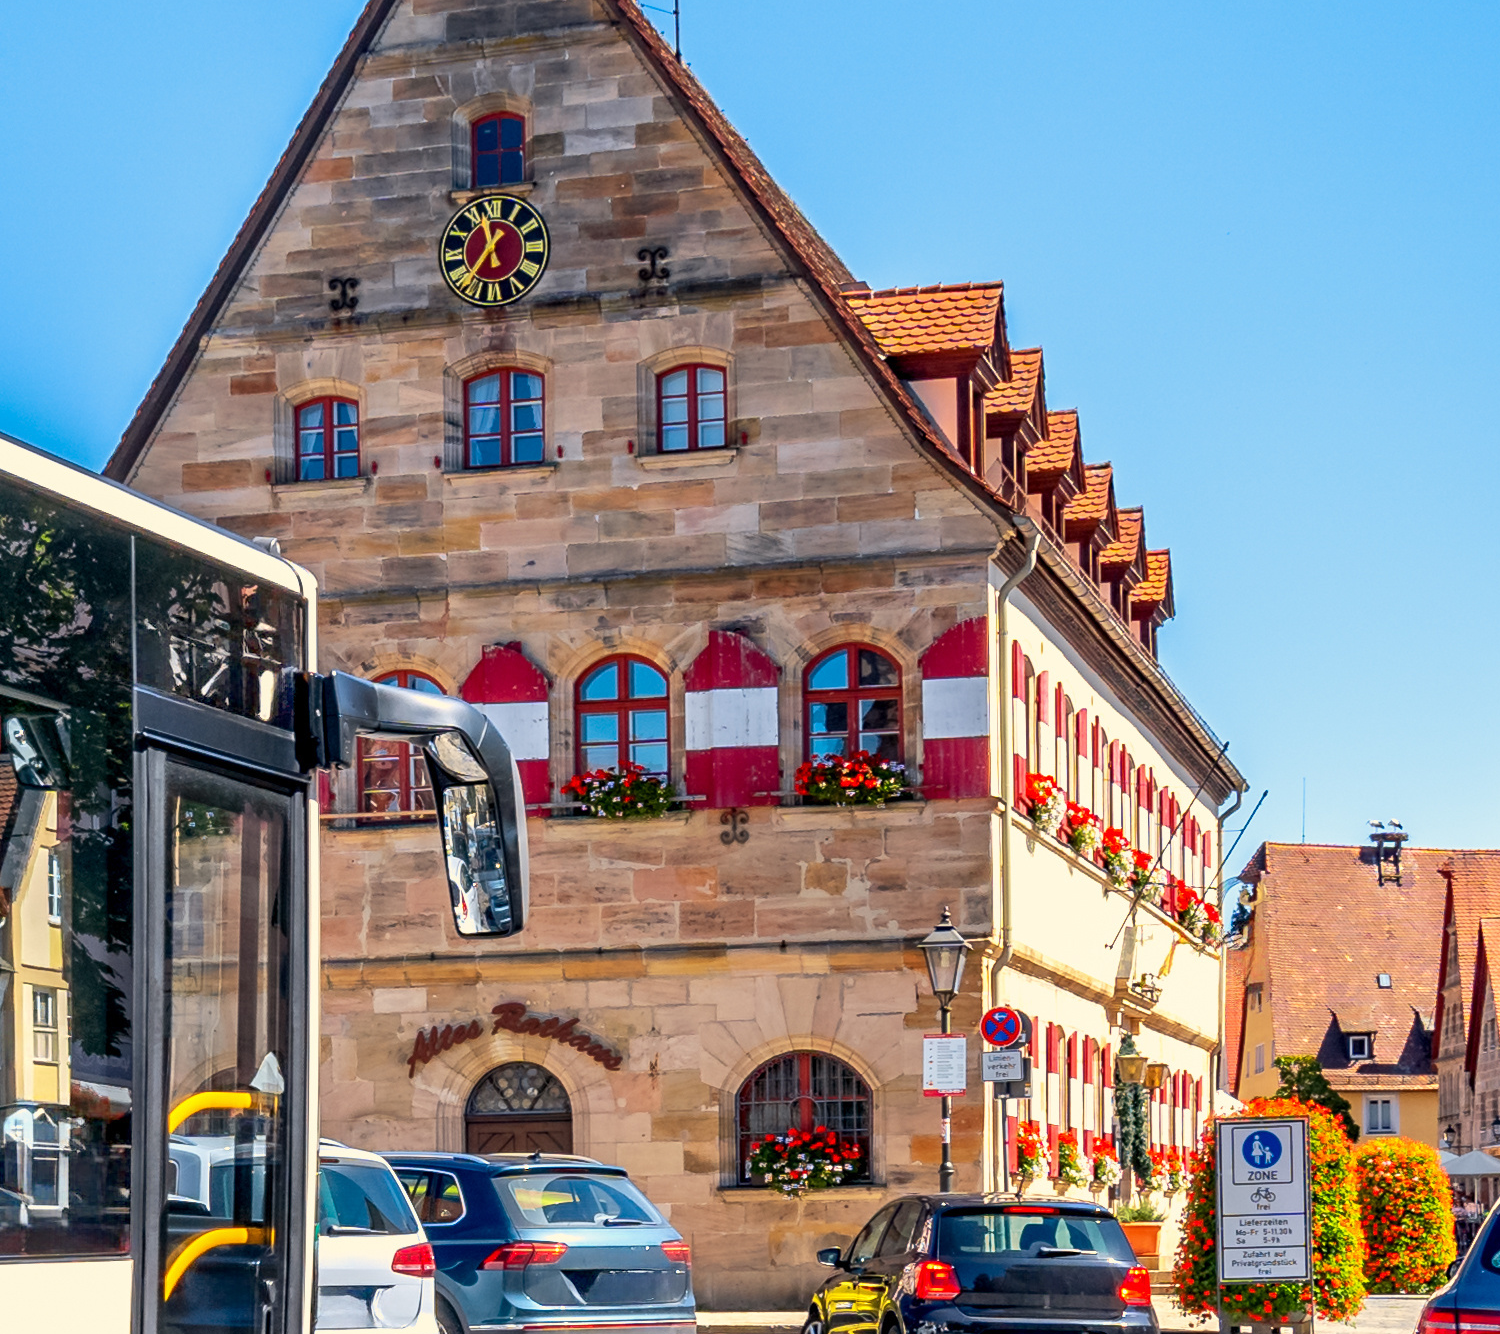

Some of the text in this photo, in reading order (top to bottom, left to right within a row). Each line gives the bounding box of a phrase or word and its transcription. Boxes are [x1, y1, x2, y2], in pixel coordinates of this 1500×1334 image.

[484, 200, 502, 219] XII
[508, 204, 522, 222] I
[464, 206, 482, 227] XI
[520, 217, 539, 235] II
[450, 225, 469, 241] X
[526, 239, 544, 253] III
[509, 277, 525, 295] V
[406, 1002, 624, 1079] Altes Rathaus
[1247, 1170, 1278, 1181] ZONE
[1257, 1203, 1271, 1211] frei
[1239, 1218, 1289, 1227] Lieferzeiten
[1236, 1229, 1259, 1237] Mo-Fr
[1236, 1237, 1246, 1245] Sa
[1242, 1250, 1287, 1259] Zufahrt auf
[1232, 1258, 1298, 1268] Privatgrundstück
[1258, 1267, 1272, 1276] frei
